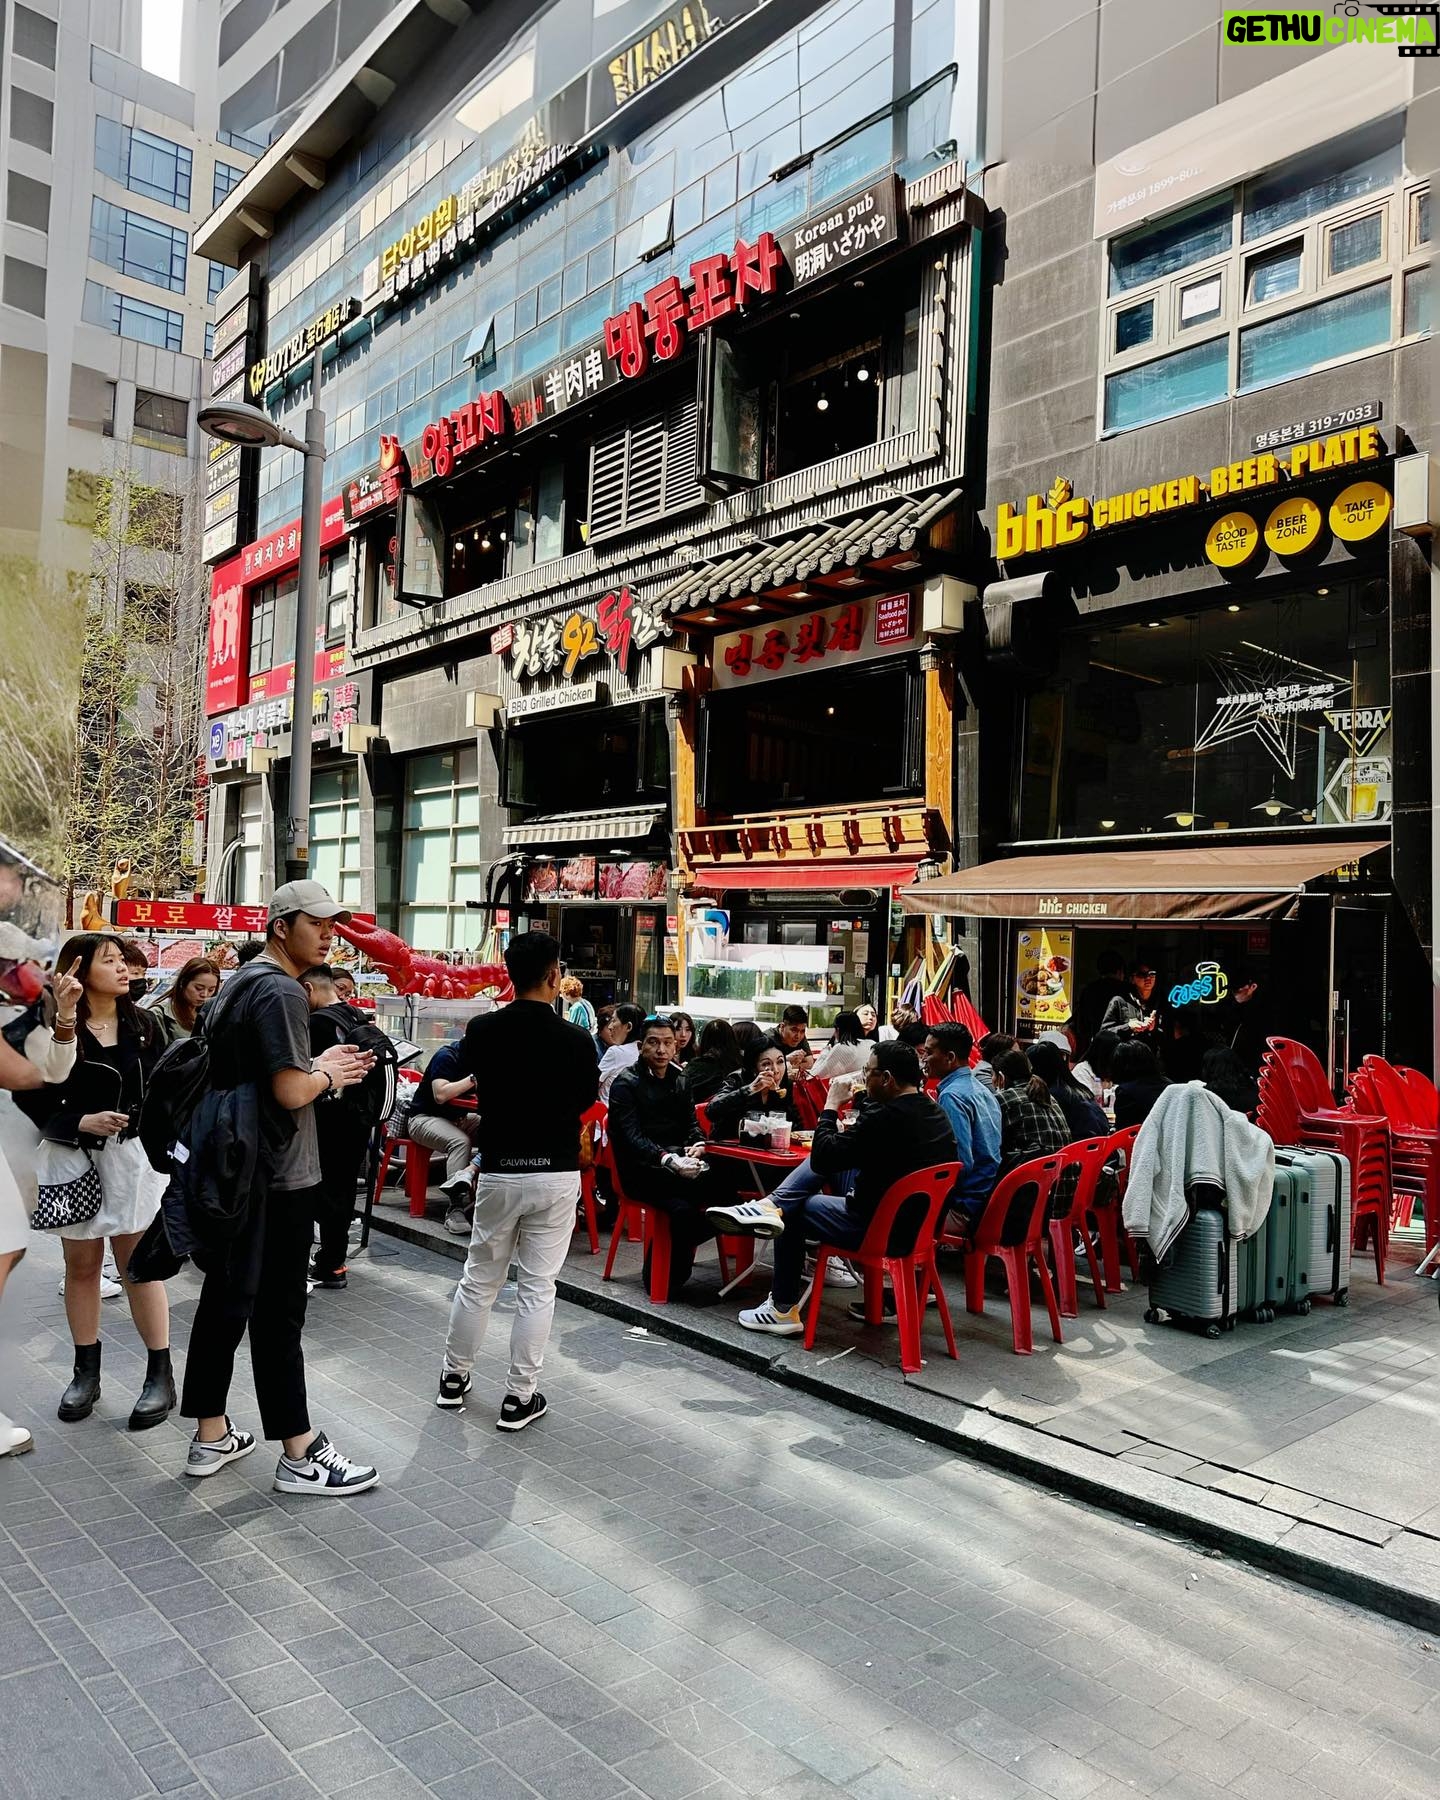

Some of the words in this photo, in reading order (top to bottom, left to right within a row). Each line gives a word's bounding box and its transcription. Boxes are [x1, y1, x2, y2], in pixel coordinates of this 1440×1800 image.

[382, 194, 457, 281] 단아의원
[794, 212, 844, 250] Korean
[847, 192, 874, 224] pub
[795, 213, 886, 282] 明洞いざかや
[603, 231, 782, 378] 명동포차
[264, 328, 309, 386] HOTEL
[545, 348, 604, 411] 羊肉串
[422, 390, 506, 477] 양꼬치
[1256, 422, 1305, 448] 명동본점
[1308, 404, 1372, 433] 319-7033
[996, 485, 1089, 560] bhc
[1290, 424, 1380, 478] PLATE
[1344, 498, 1375, 513] TAKE
[1215, 527, 1248, 543] GOOD
[1276, 514, 1308, 529] BEER
[1276, 525, 1308, 540] ZONE
[253, 529, 297, 569] 돼지상회
[1215, 539, 1247, 554] TASTE
[878, 610, 898, 621] Seafood
[897, 608, 908, 617] pub
[511, 700, 528, 714] BBQ
[530, 695, 556, 709] Grilled
[558, 688, 593, 705] Chicken
[1331, 709, 1387, 732] TERRA
[1039, 897, 1063, 914] bhc
[1066, 903, 1108, 915] CHICKEN
[500, 1158, 528, 1167] CALVIN
[528, 1157, 551, 1167] KLEIN
